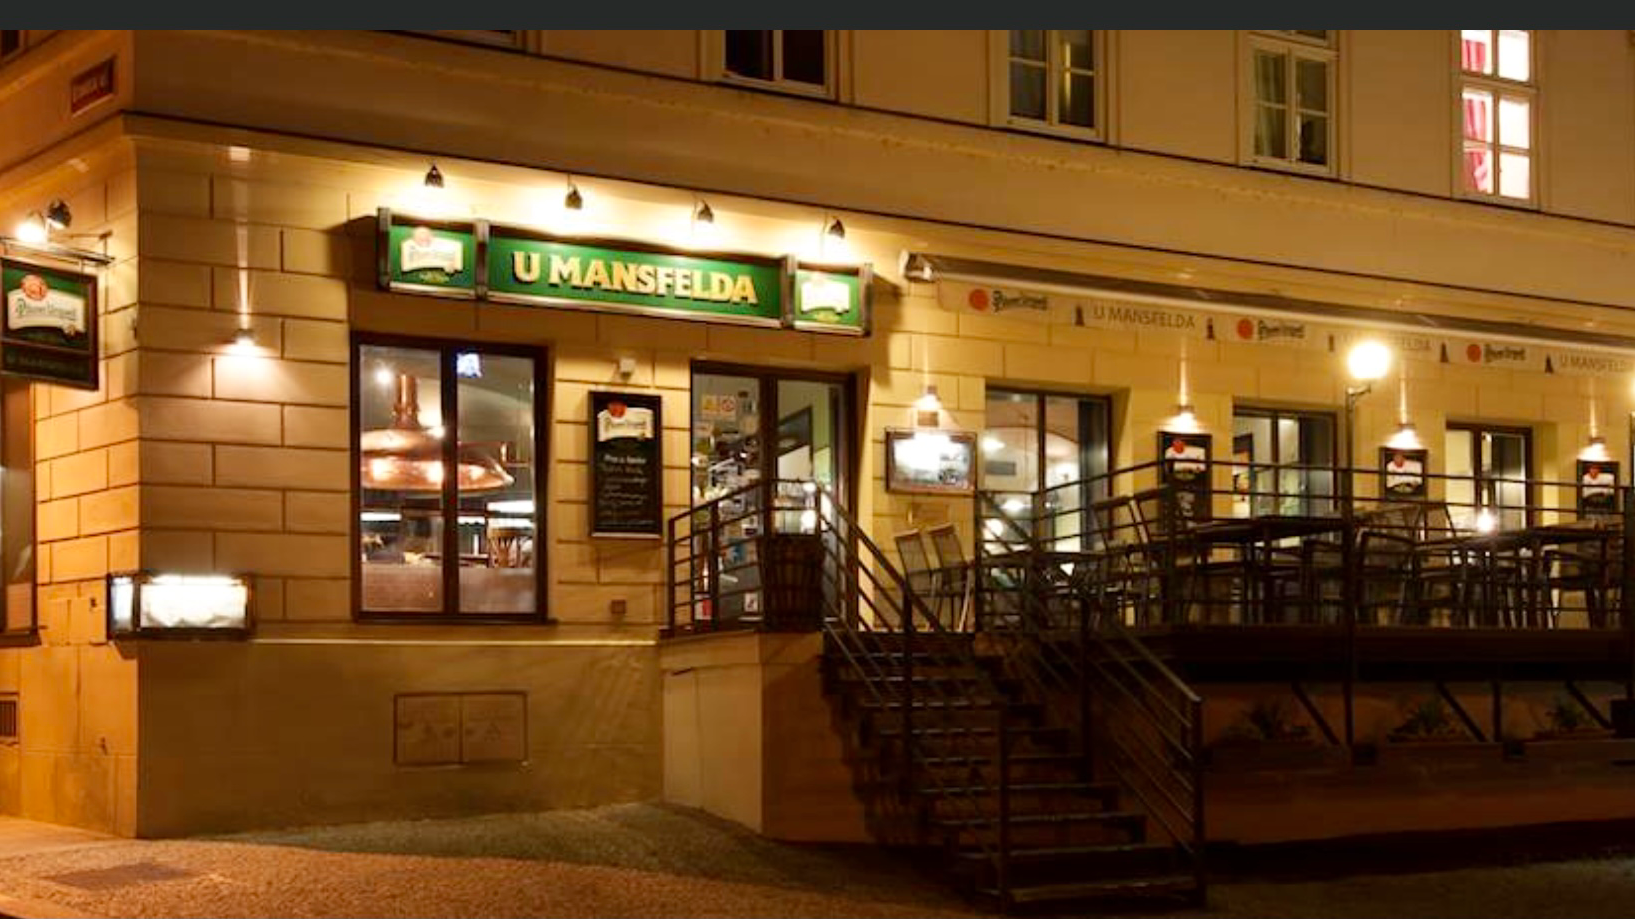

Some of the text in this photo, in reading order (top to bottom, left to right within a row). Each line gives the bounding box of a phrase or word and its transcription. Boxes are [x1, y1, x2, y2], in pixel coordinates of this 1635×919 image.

[513, 250, 758, 305] U MANSFELDA
[1107, 306, 1196, 329] MANSFELDA
